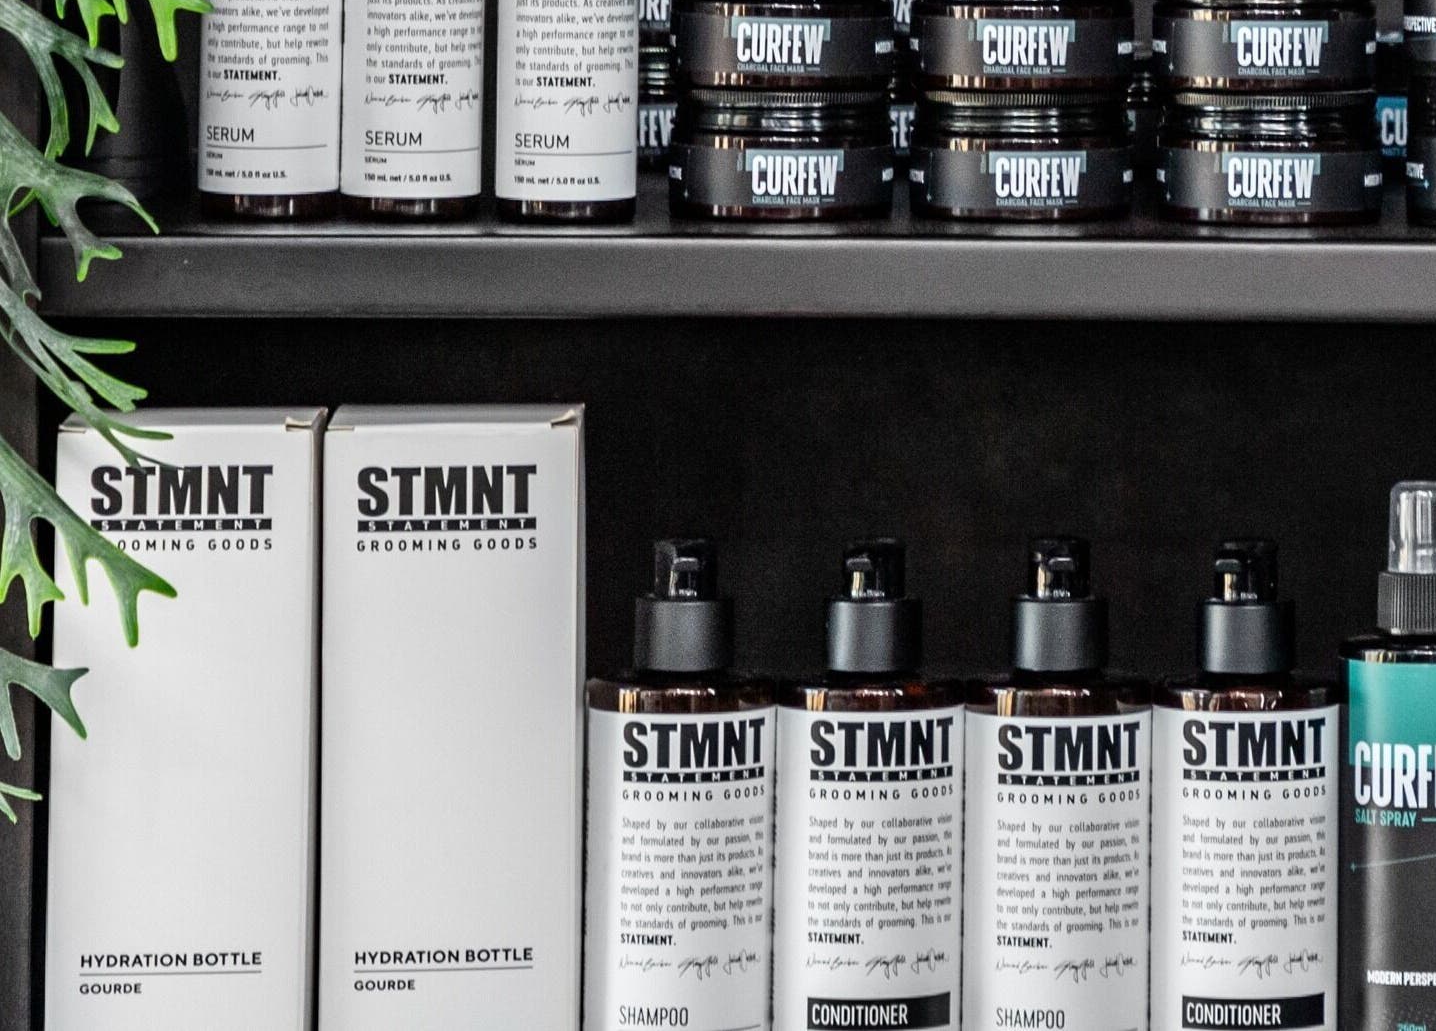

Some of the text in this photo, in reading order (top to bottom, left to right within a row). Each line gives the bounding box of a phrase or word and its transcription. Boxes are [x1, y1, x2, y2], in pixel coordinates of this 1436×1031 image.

[736, 21, 825, 64] CURFEW
[982, 24, 1070, 66] CURFEW
[1236, 26, 1323, 68] CURFEW
[206, 125, 254, 142] SERUM
[365, 130, 422, 147] SERUM
[515, 133, 569, 149] SERUM
[751, 154, 838, 196] CURFEW
[994, 156, 1081, 197] CURFEW
[1227, 157, 1314, 199] CURFEW
[91, 465, 273, 516] STMNT
[356, 464, 537, 517] STMNT
[101, 520, 262, 530] STATEMENT
[367, 519, 529, 532] STATEMENT
[118, 539, 272, 551] OOMING GOODS
[356, 537, 537, 553] GROOMING GOODS
[623, 717, 765, 769] STMNT
[810, 717, 953, 767] STMNT
[998, 721, 1140, 772] STMNT
[1183, 717, 1326, 767] STMNT
[622, 785, 765, 802] GROOMING GOODS
[809, 784, 953, 800] GROOMING GOODS
[998, 789, 1140, 804] GROOMING GOODS
[1182, 785, 1326, 800] GROOMING GOODS
[1355, 808, 1417, 828] SALT SPRAY
[80, 952, 263, 969] HYDRATION BOTTLE
[354, 948, 533, 966] HYDRATION BOTTLE
[354, 979, 416, 992] GOURDE
[1366, 970, 1402, 985] MODERN
[79, 982, 142, 995] GOURDE
[619, 1005, 689, 1027] SHAMPOO
[812, 1003, 908, 1026] CONDITIONER
[996, 1007, 1065, 1029] SHAMPOO
[1186, 1002, 1281, 1025] CONDITIONER
